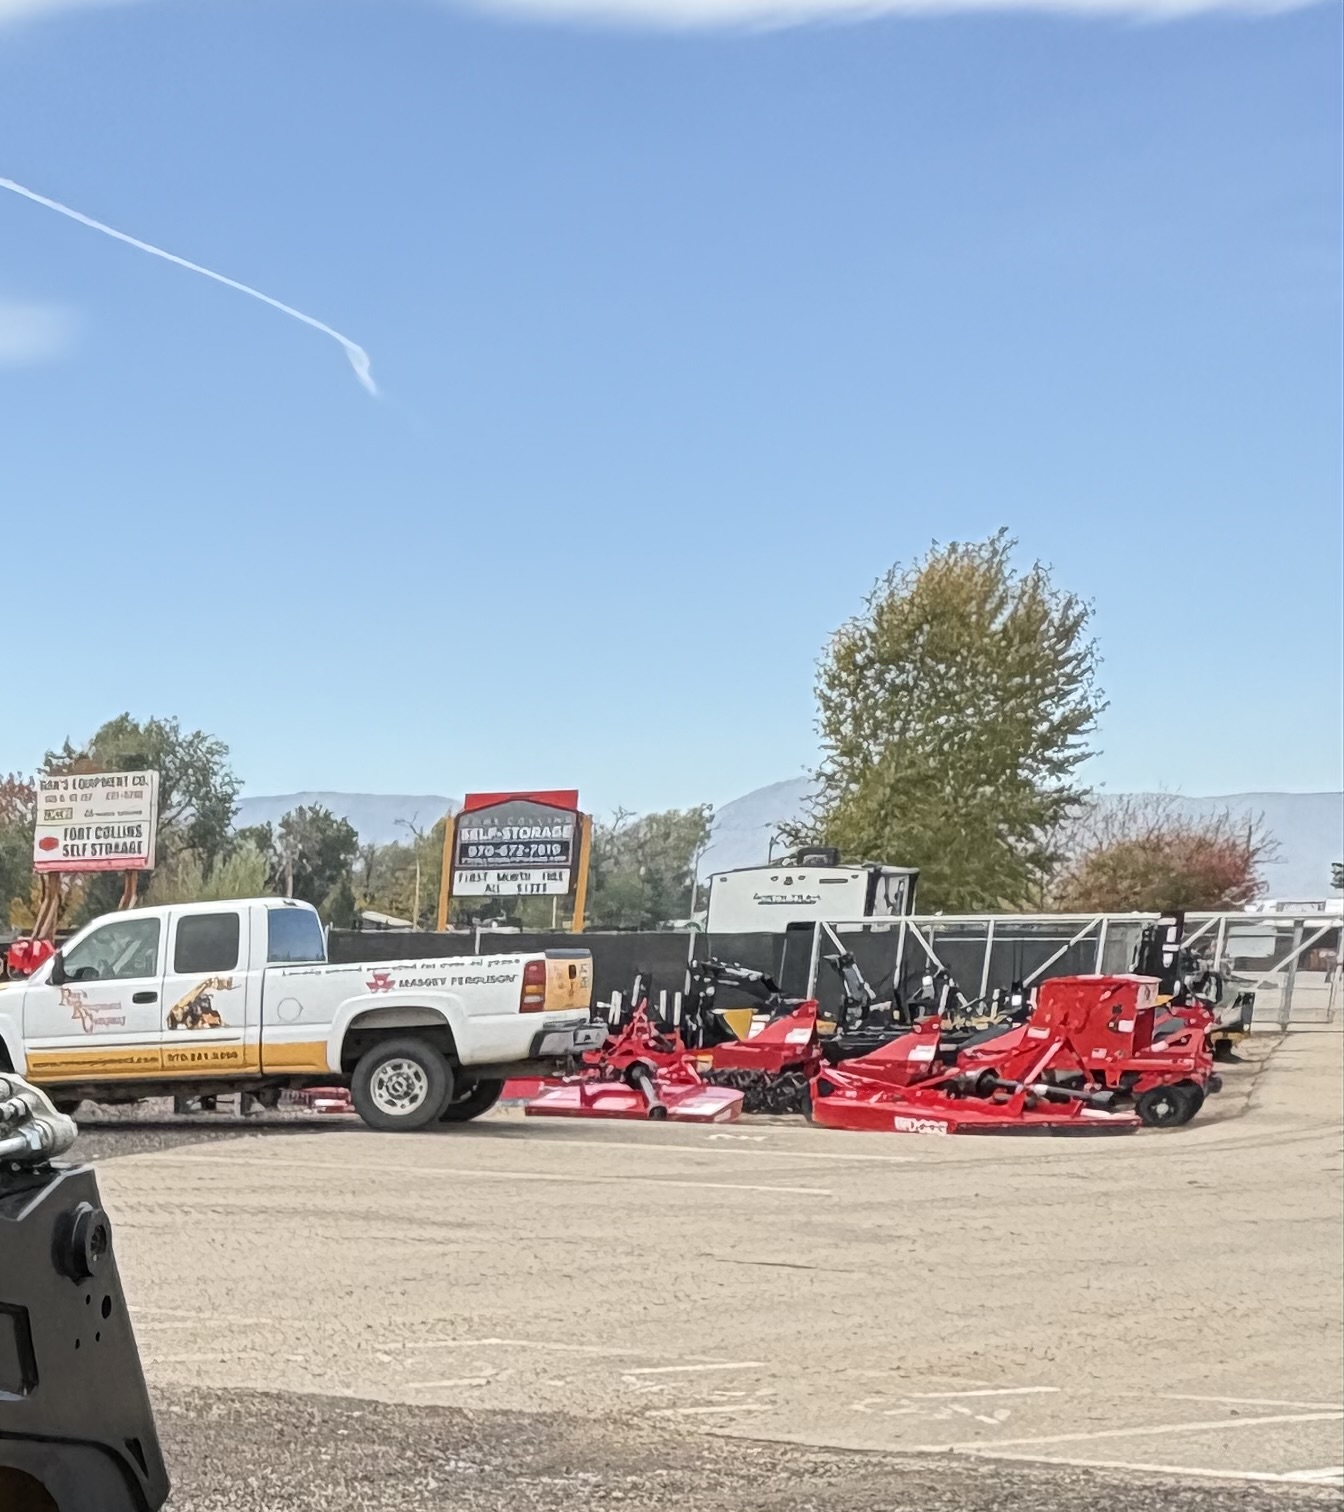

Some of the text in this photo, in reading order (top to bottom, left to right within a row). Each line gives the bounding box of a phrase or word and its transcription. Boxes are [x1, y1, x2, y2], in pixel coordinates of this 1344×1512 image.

[63, 825, 142, 841] FORT COLLINS
[62, 841, 143, 857] SELF STORAGE
